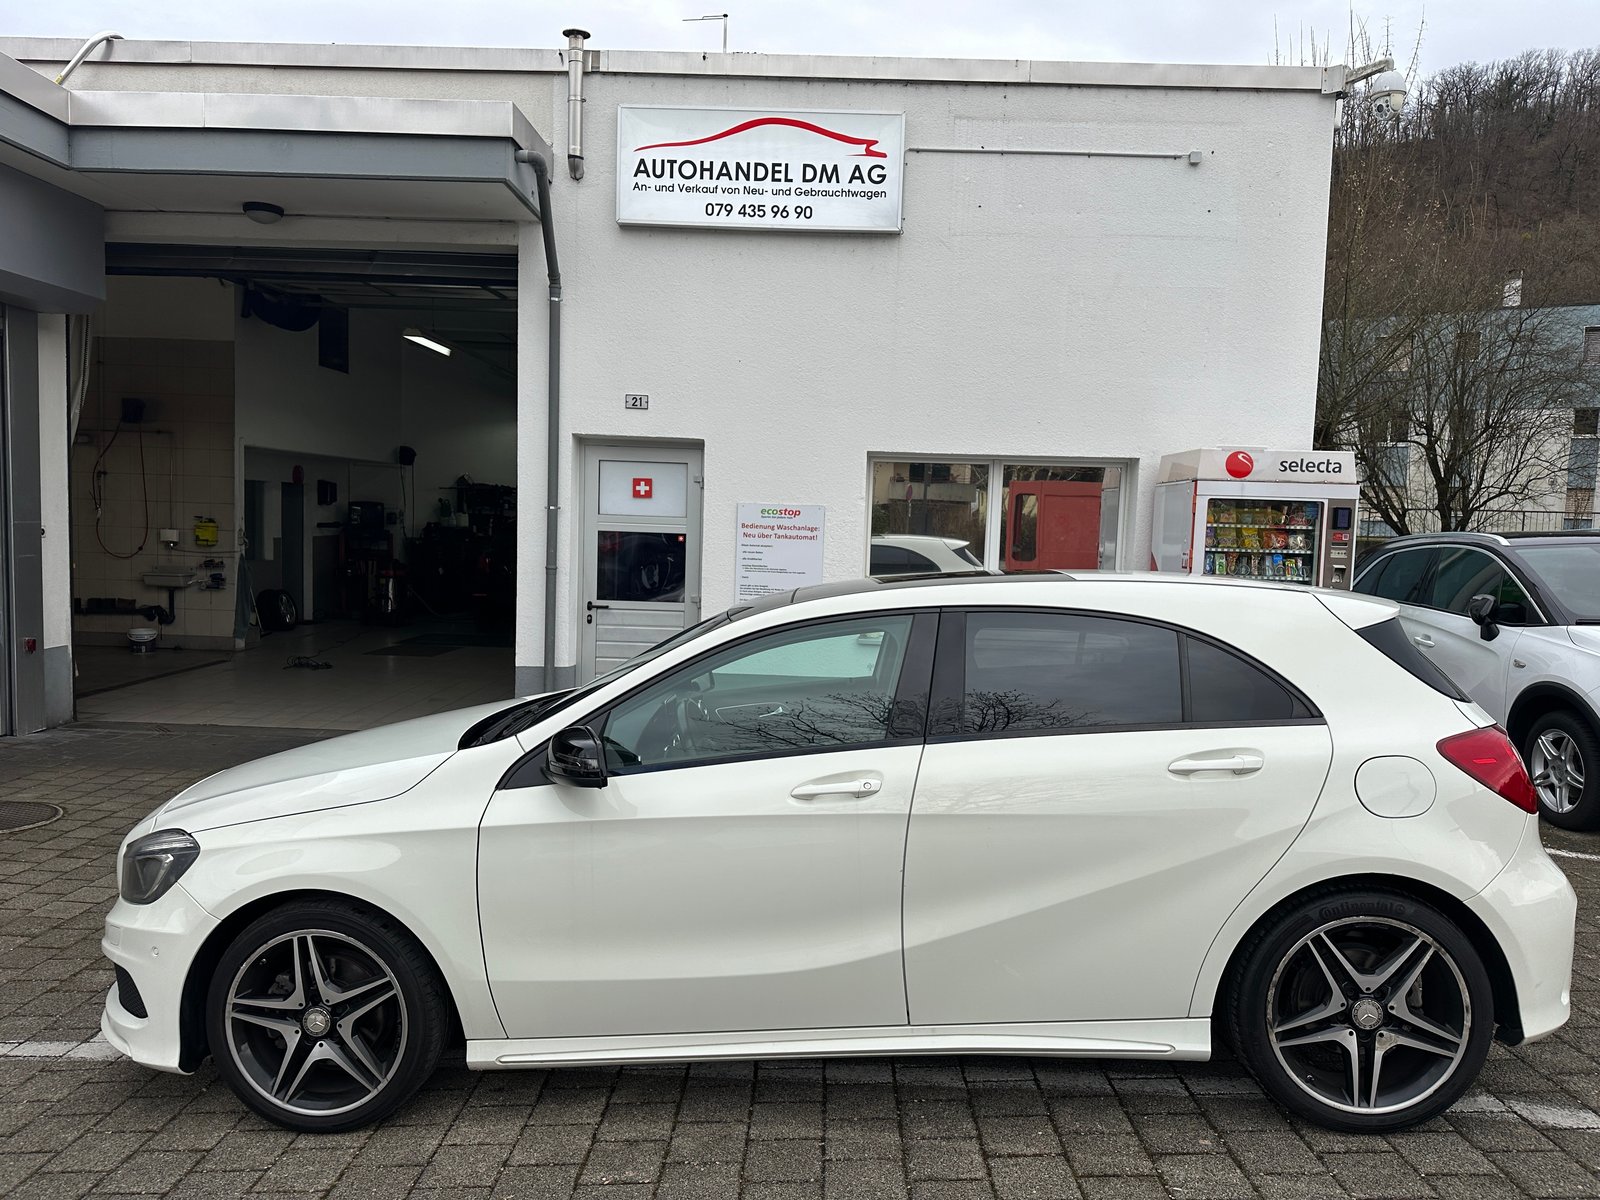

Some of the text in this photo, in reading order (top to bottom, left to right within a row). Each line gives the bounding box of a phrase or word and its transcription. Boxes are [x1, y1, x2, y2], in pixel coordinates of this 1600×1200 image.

[633, 159, 887, 184] AUTOHANDEL DM AG
[633, 182, 887, 200] An- und Verkauf von Neu- und Gebrauchtwagen
[705, 203, 813, 219] 079 435 96 90
[631, 397, 642, 407] 21
[1279, 458, 1342, 473] selecta
[761, 508, 800, 518] ecostop
[741, 523, 820, 532] Bedienung Waschanlage:
[1320, 902, 1394, 918] Continental
